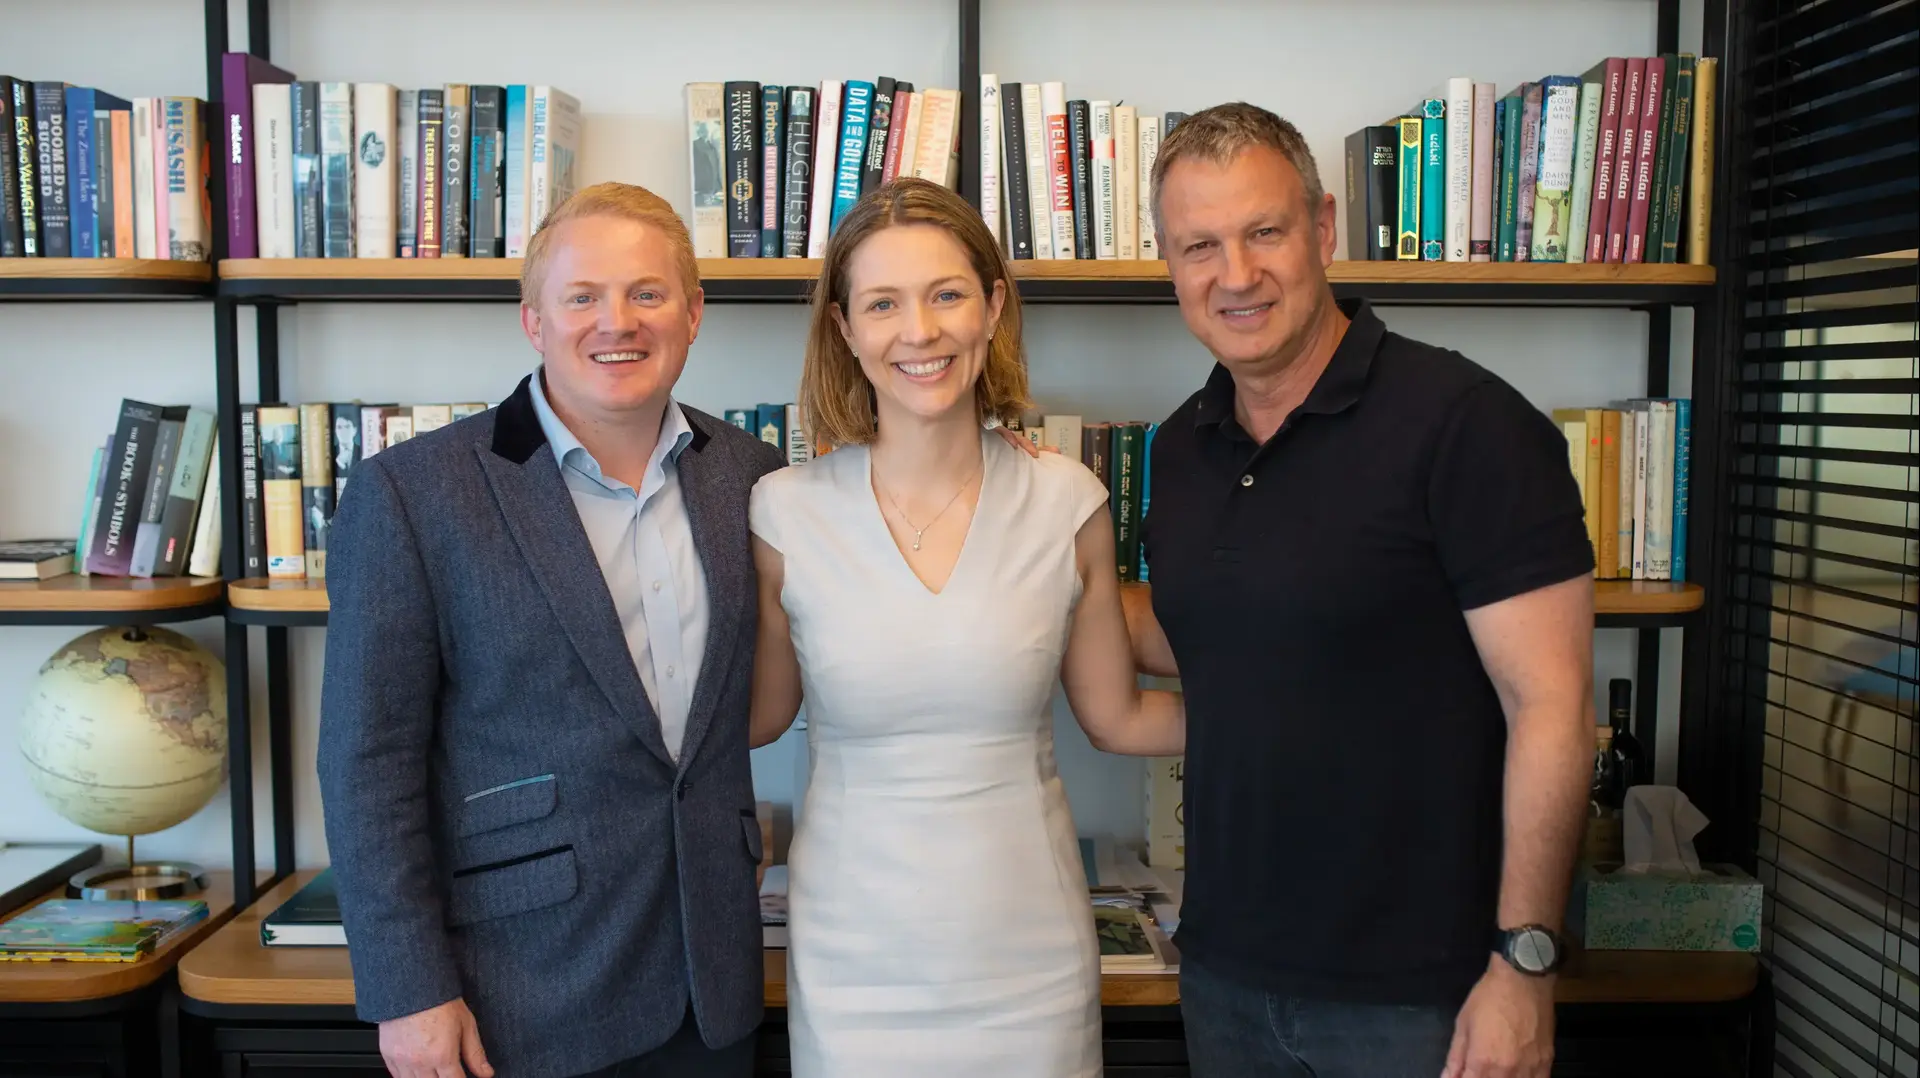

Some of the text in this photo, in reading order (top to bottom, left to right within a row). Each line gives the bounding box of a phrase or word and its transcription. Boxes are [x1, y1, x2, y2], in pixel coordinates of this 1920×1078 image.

[847, 87, 868, 123] DATA
[876, 93, 893, 104] No.
[15, 116, 31, 150] JESUS
[77, 118, 88, 137] The
[425, 127, 435, 142] THE
[534, 96, 547, 162] TRAILBLAZER
[731, 90, 741, 151] TYCOONS
[741, 91, 752, 151] THE LAST
[765, 101, 778, 145] Forbes
[846, 126, 863, 137] AND
[892, 128, 902, 144] From
[1553, 127, 1568, 135] 100
[1583, 95, 1597, 171] JERUSALEM
[37, 120, 52, 197] SUCCEED
[50, 113, 66, 204] DOOMED TO
[78, 140, 90, 175] Zionist
[165, 101, 186, 194] MUSASHI
[447, 110, 461, 186] SOROS
[874, 129, 888, 170] Re-wired
[887, 147, 899, 176] Concept
[1051, 118, 1070, 207] TELL TO WIN
[1075, 110, 1086, 184] CULTURE CODE
[19, 163, 35, 216] YAHWEH
[424, 183, 434, 197] THE
[425, 166, 435, 182] AND
[790, 121, 810, 225] HUGHES
[838, 138, 862, 200] GOLIATH
[424, 199, 434, 222] OLIVE
[1102, 165, 1112, 246] ARIANNA HUFFINGTON
[423, 221, 434, 240] TREE
[120, 441, 138, 482] BOOK
[242, 411, 257, 500] THE BATTLE OF THE ATLANTIC
[791, 430, 808, 463] CONFR
[1681, 428, 1690, 515] JERUSALEM
[105, 491, 128, 557] SYMBOLS
[1120, 526, 1128, 542] דוד
